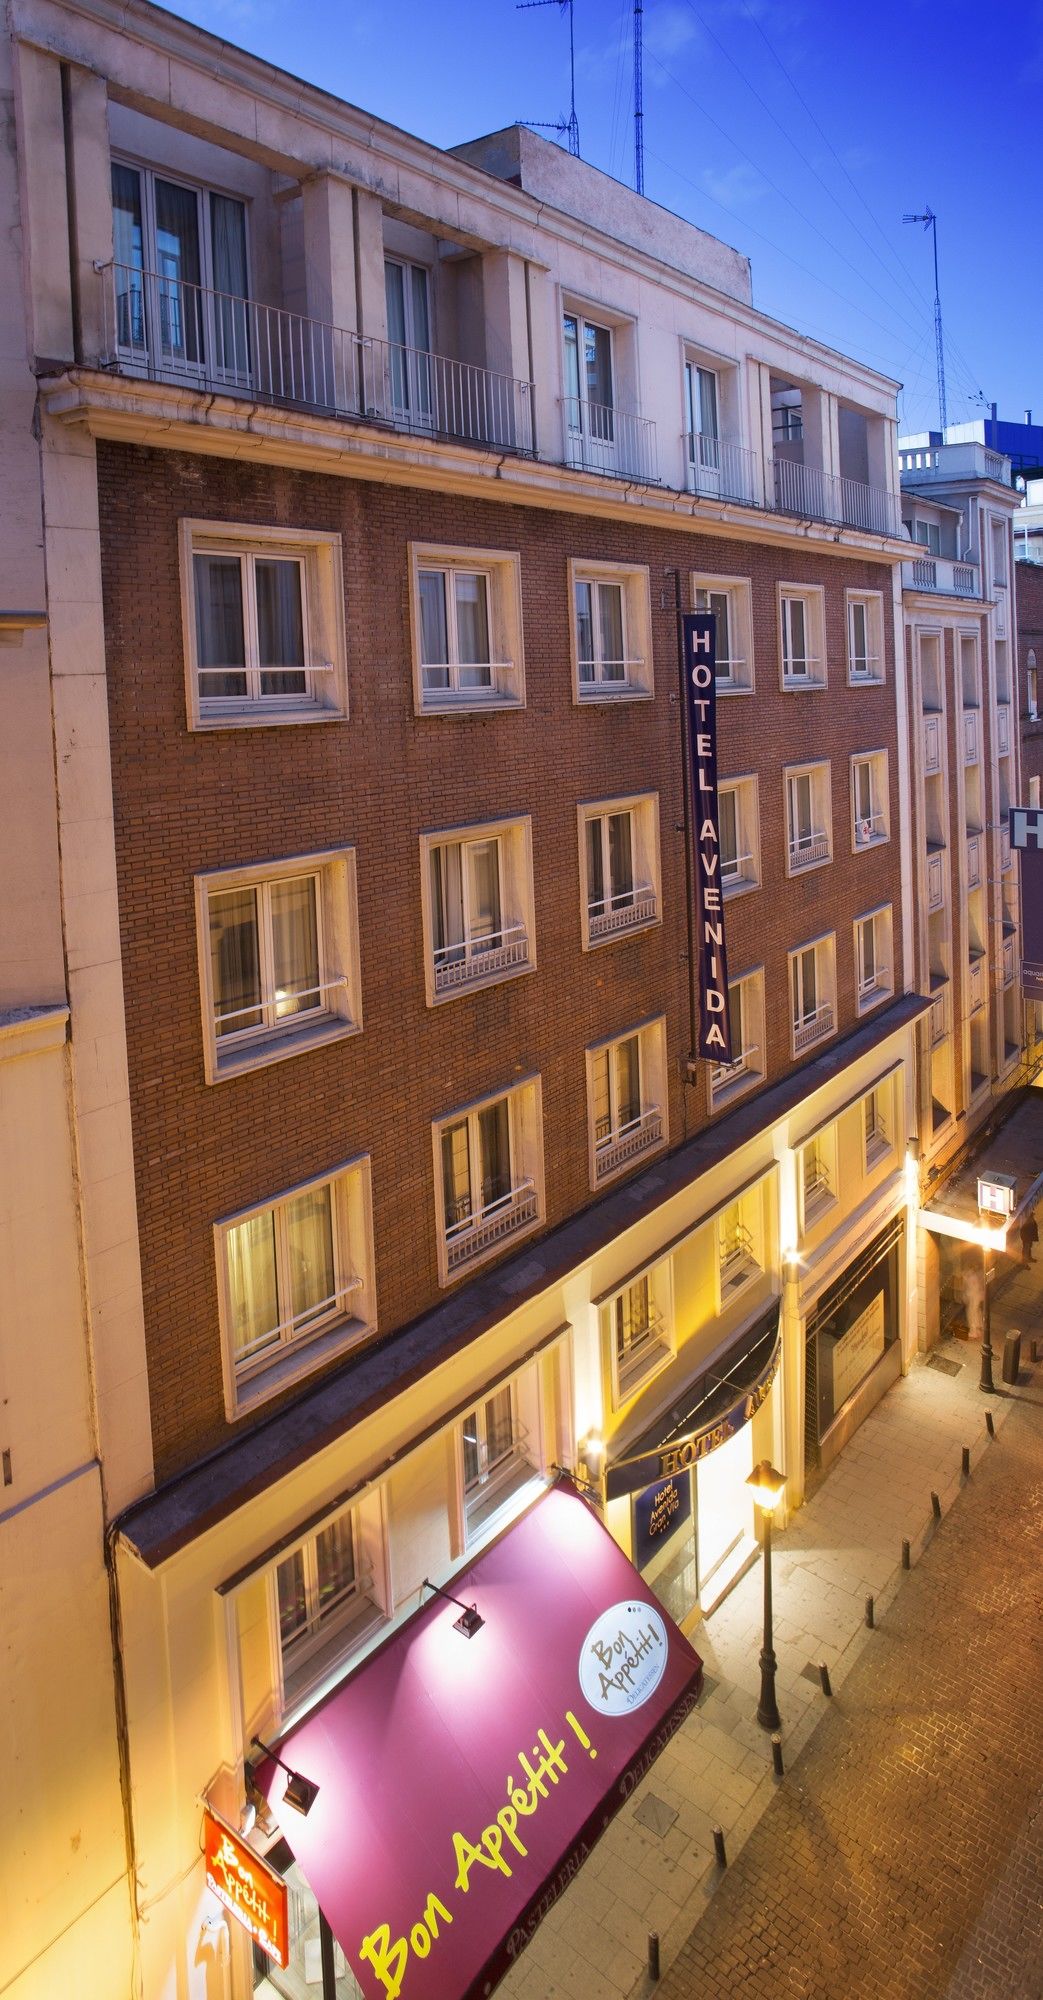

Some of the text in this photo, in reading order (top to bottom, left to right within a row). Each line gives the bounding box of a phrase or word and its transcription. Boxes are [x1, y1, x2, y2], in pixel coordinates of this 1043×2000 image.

[692, 630, 726, 1048] HOTEL AVENIDA
[660, 1419, 735, 1478] HOTEL
[650, 1489, 678, 1524] Avenida
[654, 1479, 673, 1507] Hotel
[649, 1514, 666, 1536] Gran
[591, 1630, 632, 1670] Bon
[221, 1833, 254, 1889] Bon
[359, 1892, 454, 2000] Bon
